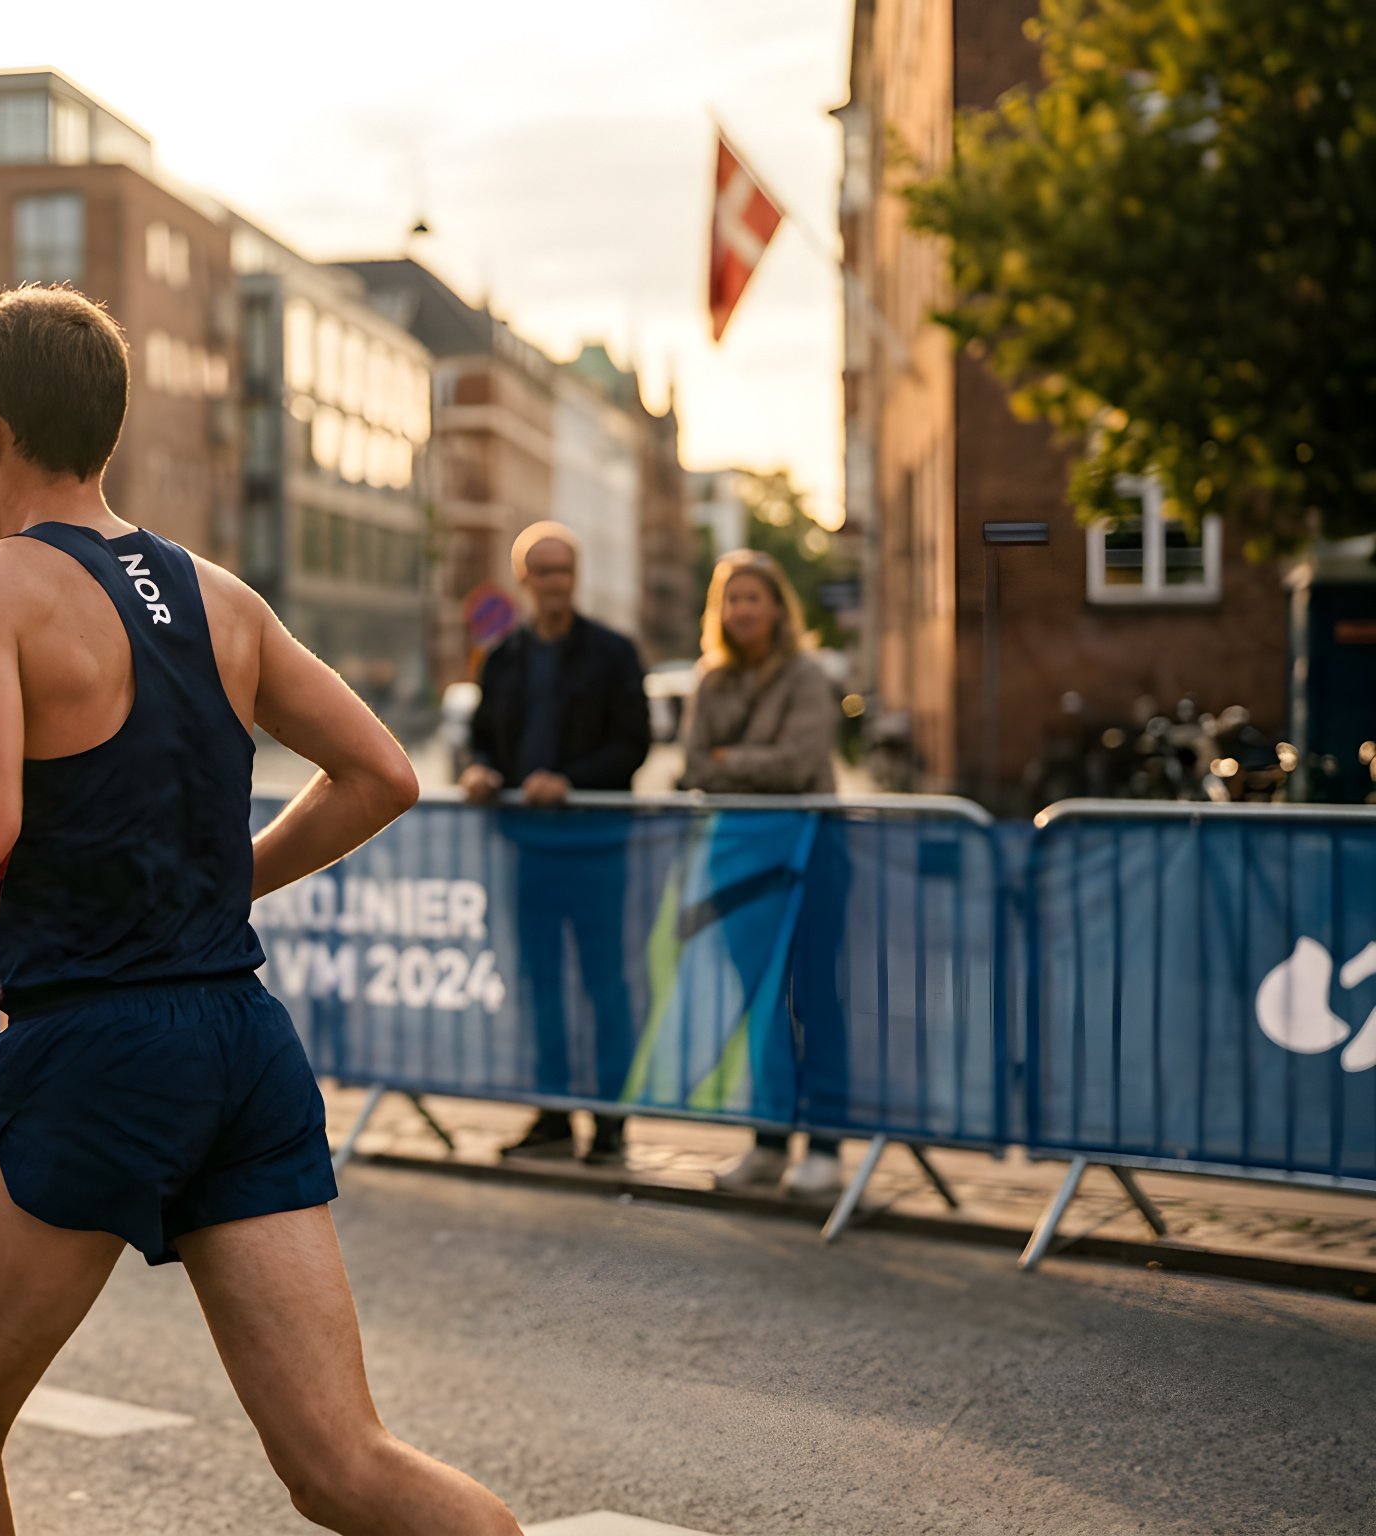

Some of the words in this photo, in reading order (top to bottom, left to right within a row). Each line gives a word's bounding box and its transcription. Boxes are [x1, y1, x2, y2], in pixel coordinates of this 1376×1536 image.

[117, 553, 172, 625] NOR
[276, 941, 356, 1002] VM
[366, 943, 505, 1013] 2024
